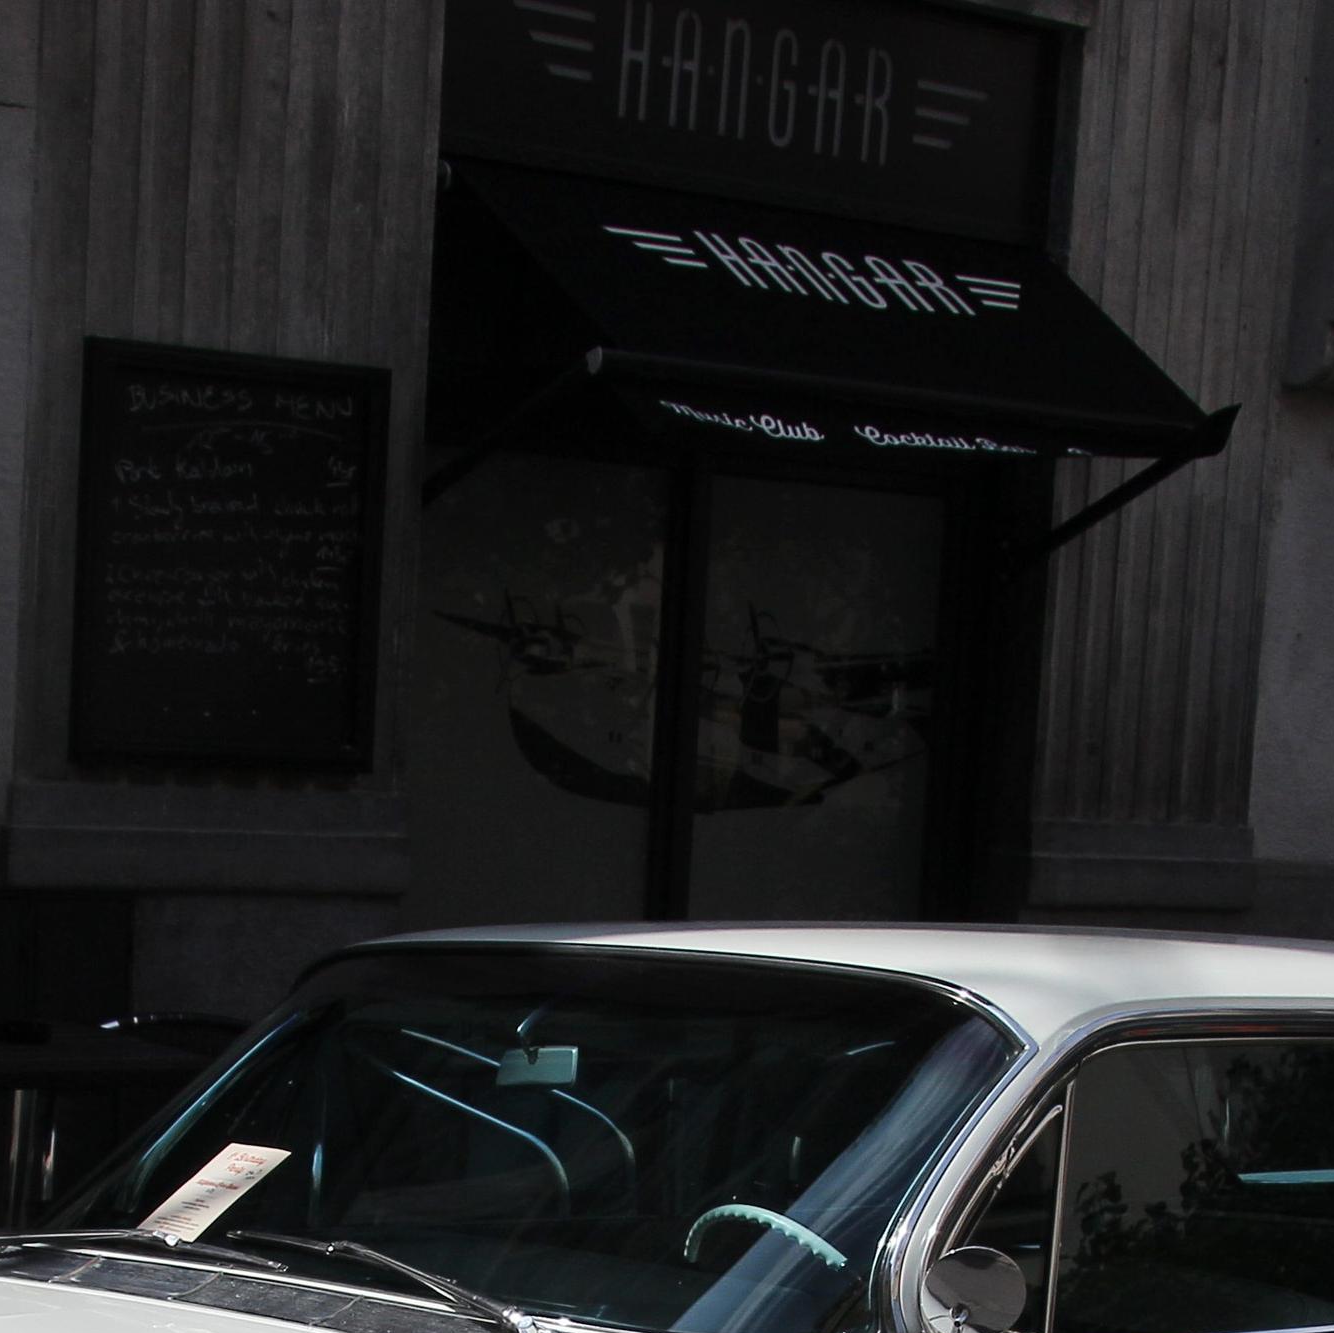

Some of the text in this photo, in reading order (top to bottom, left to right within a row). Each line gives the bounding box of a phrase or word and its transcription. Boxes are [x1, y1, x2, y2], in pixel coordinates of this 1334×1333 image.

[617, 0, 893, 167] HANGAR
[693, 230, 977, 316] HANGAR
[749, 414, 826, 441] Club
[854, 425, 976, 449] Cocktail
